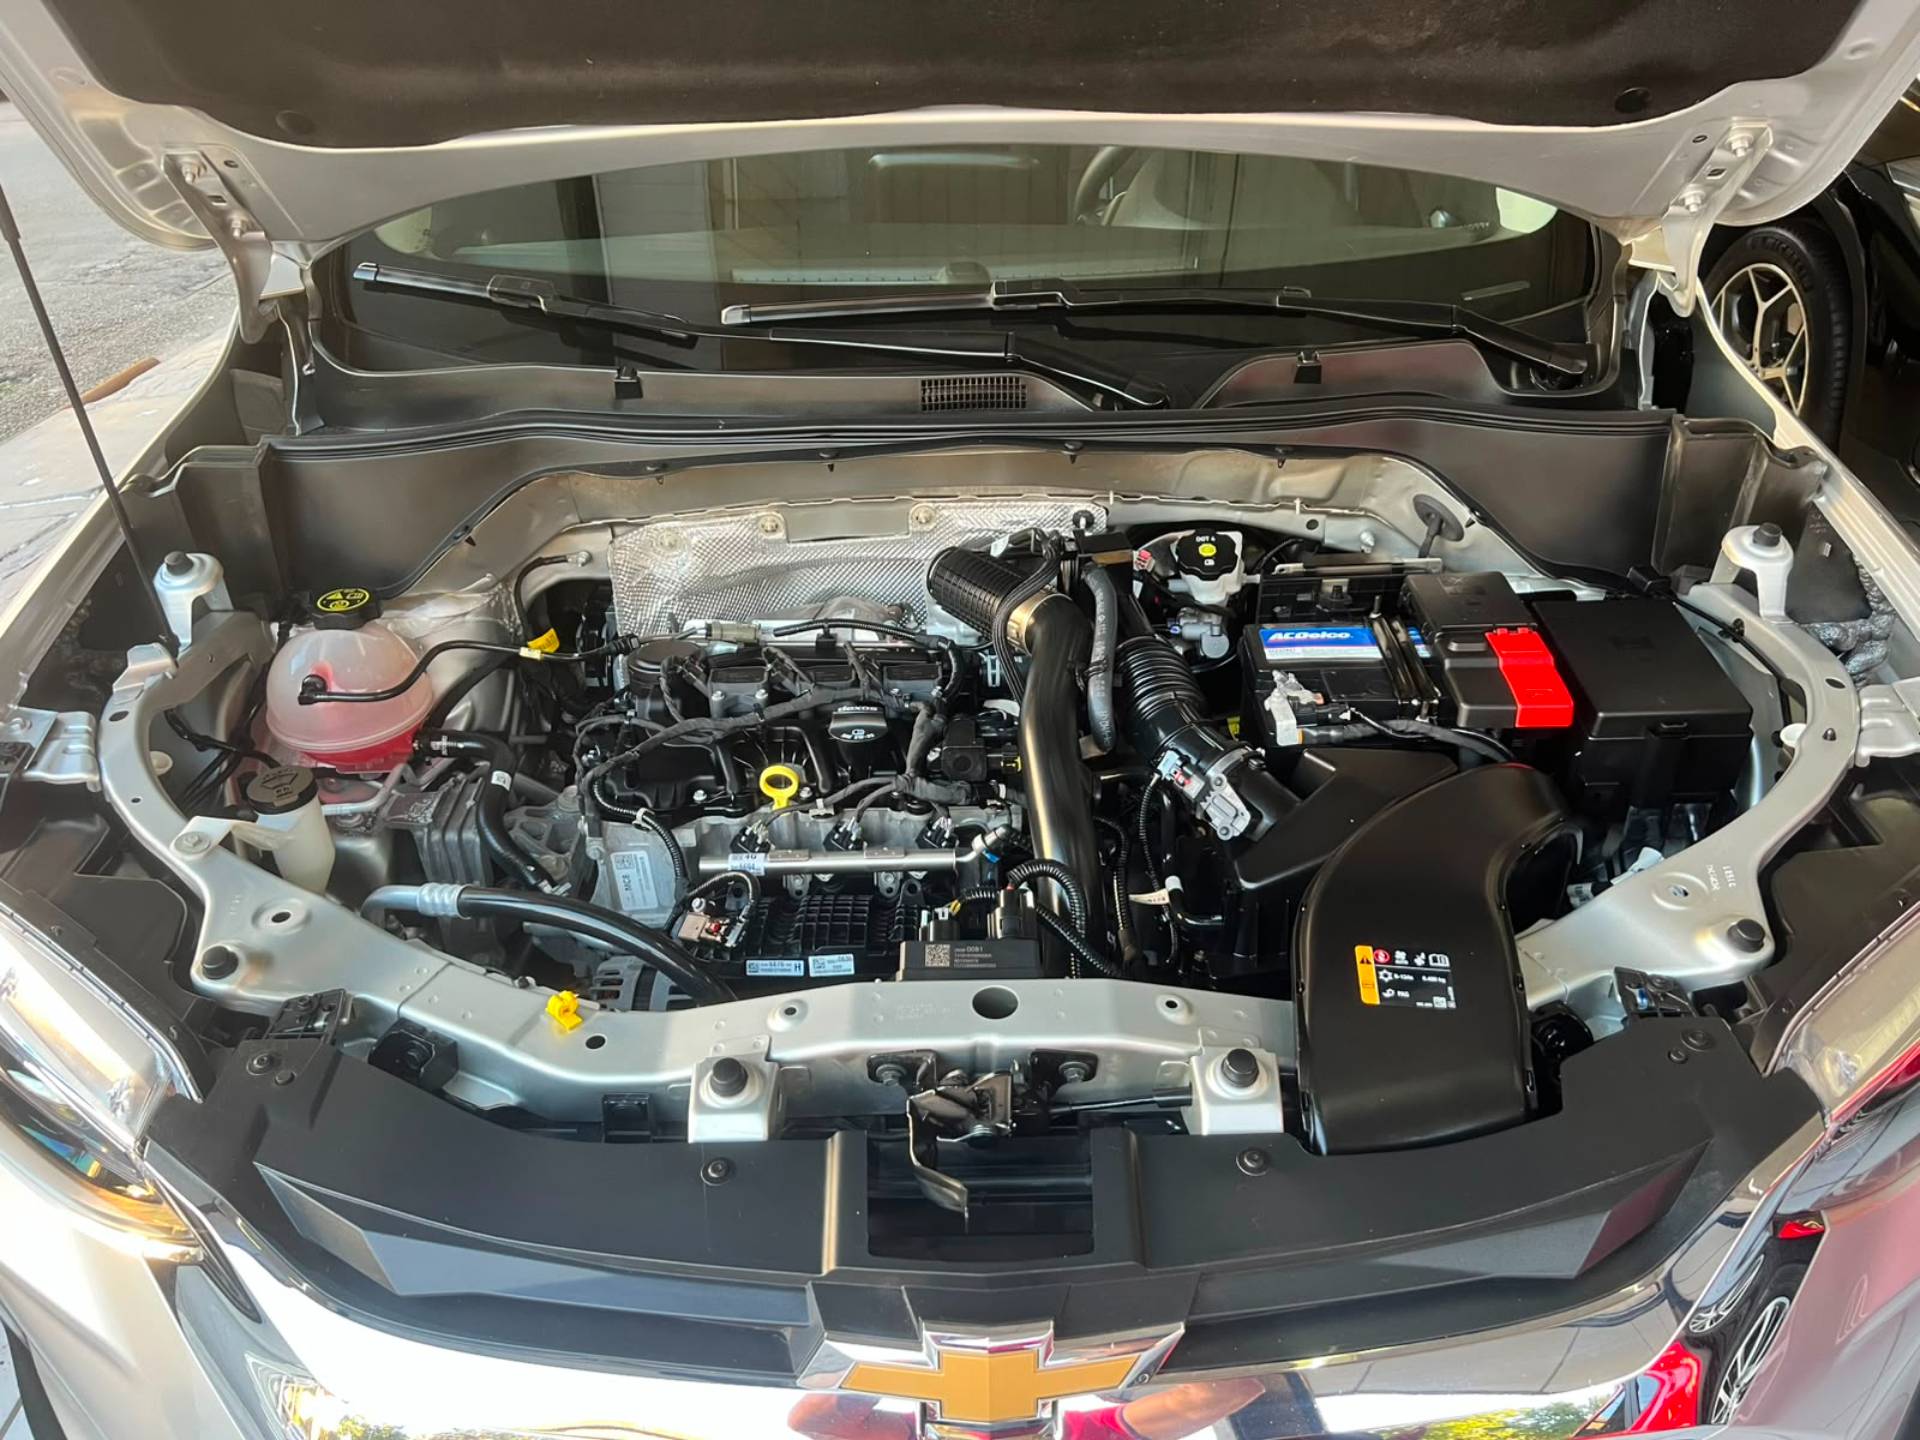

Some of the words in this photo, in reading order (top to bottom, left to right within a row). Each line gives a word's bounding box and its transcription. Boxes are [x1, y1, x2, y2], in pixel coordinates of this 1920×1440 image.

[1195, 535, 1210, 543] DOT
[1269, 631, 1351, 641] ACDelco
[794, 963, 801, 973] H
